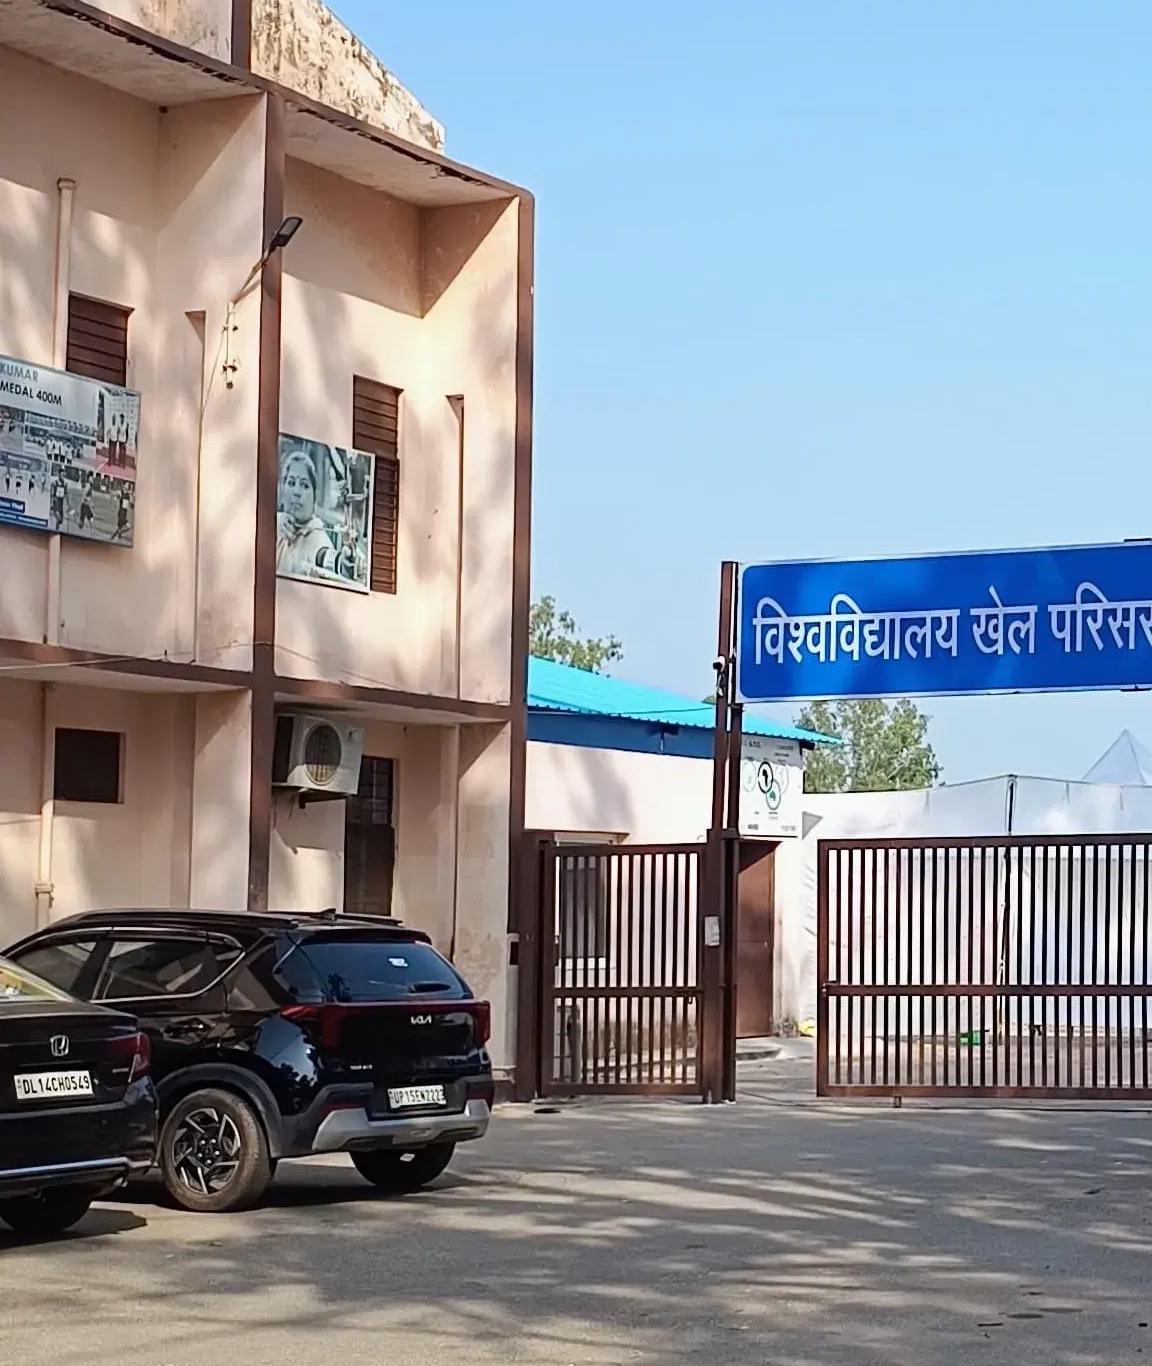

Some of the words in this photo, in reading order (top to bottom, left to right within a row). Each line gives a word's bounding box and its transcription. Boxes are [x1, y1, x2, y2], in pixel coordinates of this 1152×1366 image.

[0, 380, 34, 399] MEDAL
[36, 390, 63, 405] 400M
[752, 593, 961, 665] विश्वविद्यालय
[969, 585, 1038, 656] खेल
[22, 1075, 91, 1095] DL14CH0549
